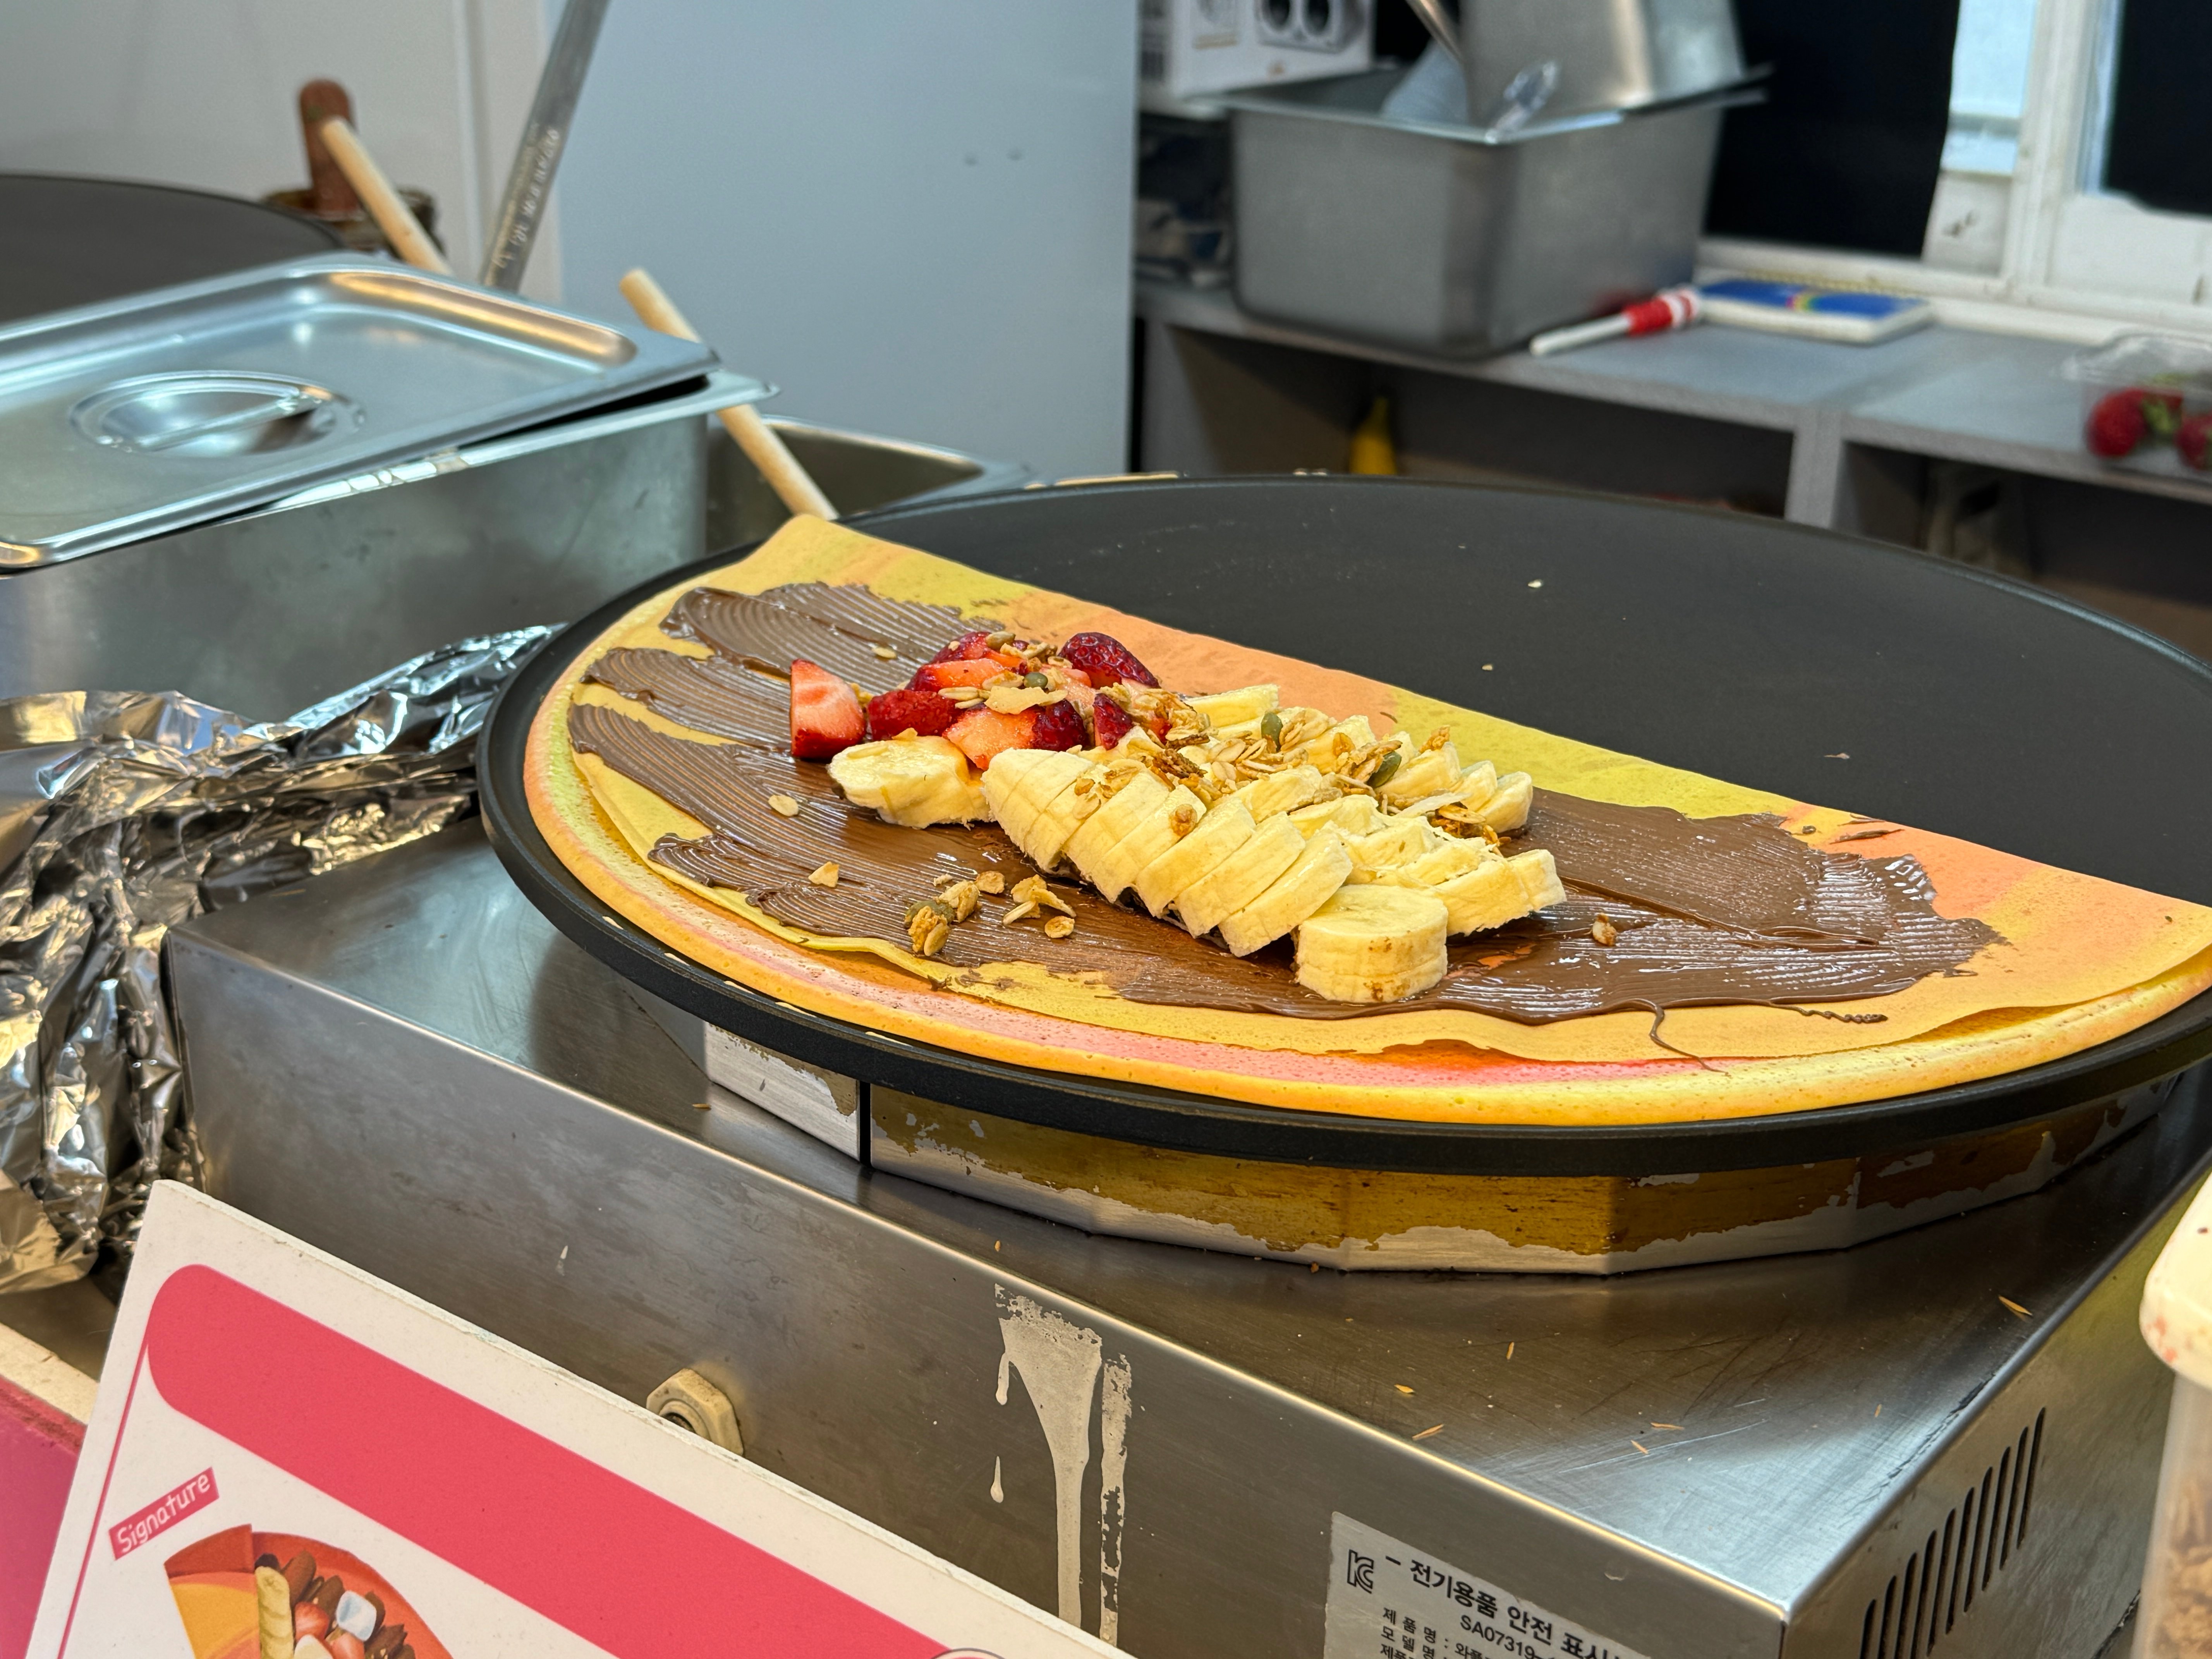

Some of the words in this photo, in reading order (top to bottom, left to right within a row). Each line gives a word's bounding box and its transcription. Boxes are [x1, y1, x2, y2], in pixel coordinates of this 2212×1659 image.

[117, 1474, 211, 1553] Signature
[1410, 1559, 1498, 1619] 전기용품
[1507, 1606, 1552, 1646] 안전
[1560, 1632, 1620, 1659] 표시
[1460, 1614, 1554, 1659] SA07319-
